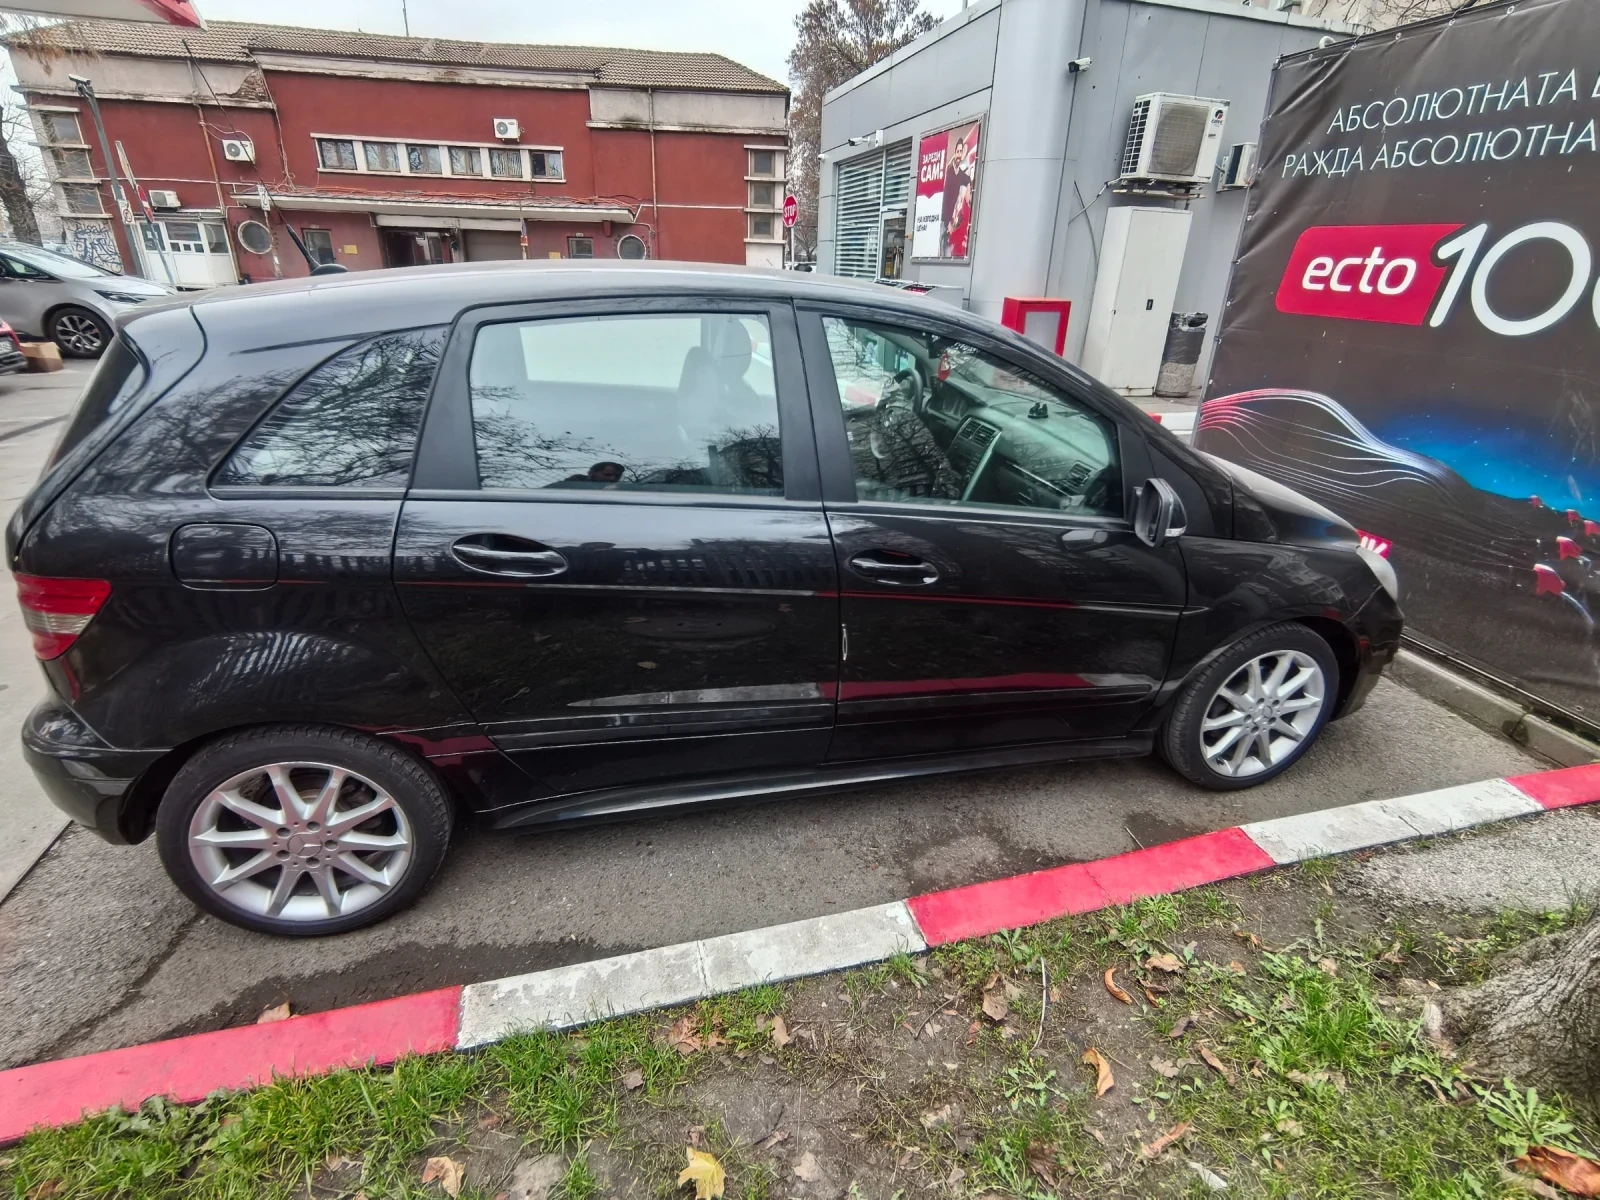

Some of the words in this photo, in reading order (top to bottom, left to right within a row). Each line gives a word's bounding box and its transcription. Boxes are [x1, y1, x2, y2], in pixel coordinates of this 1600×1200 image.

[1327, 67, 1577, 134] АБСОЛЮТНАТА
[1281, 147, 1364, 178] РАЖДА
[1370, 118, 1597, 170] АБСОЛЮТНА
[784, 204, 796, 218] STOP
[1302, 246, 1417, 295] ecto
[1428, 221, 1600, 336] 10
